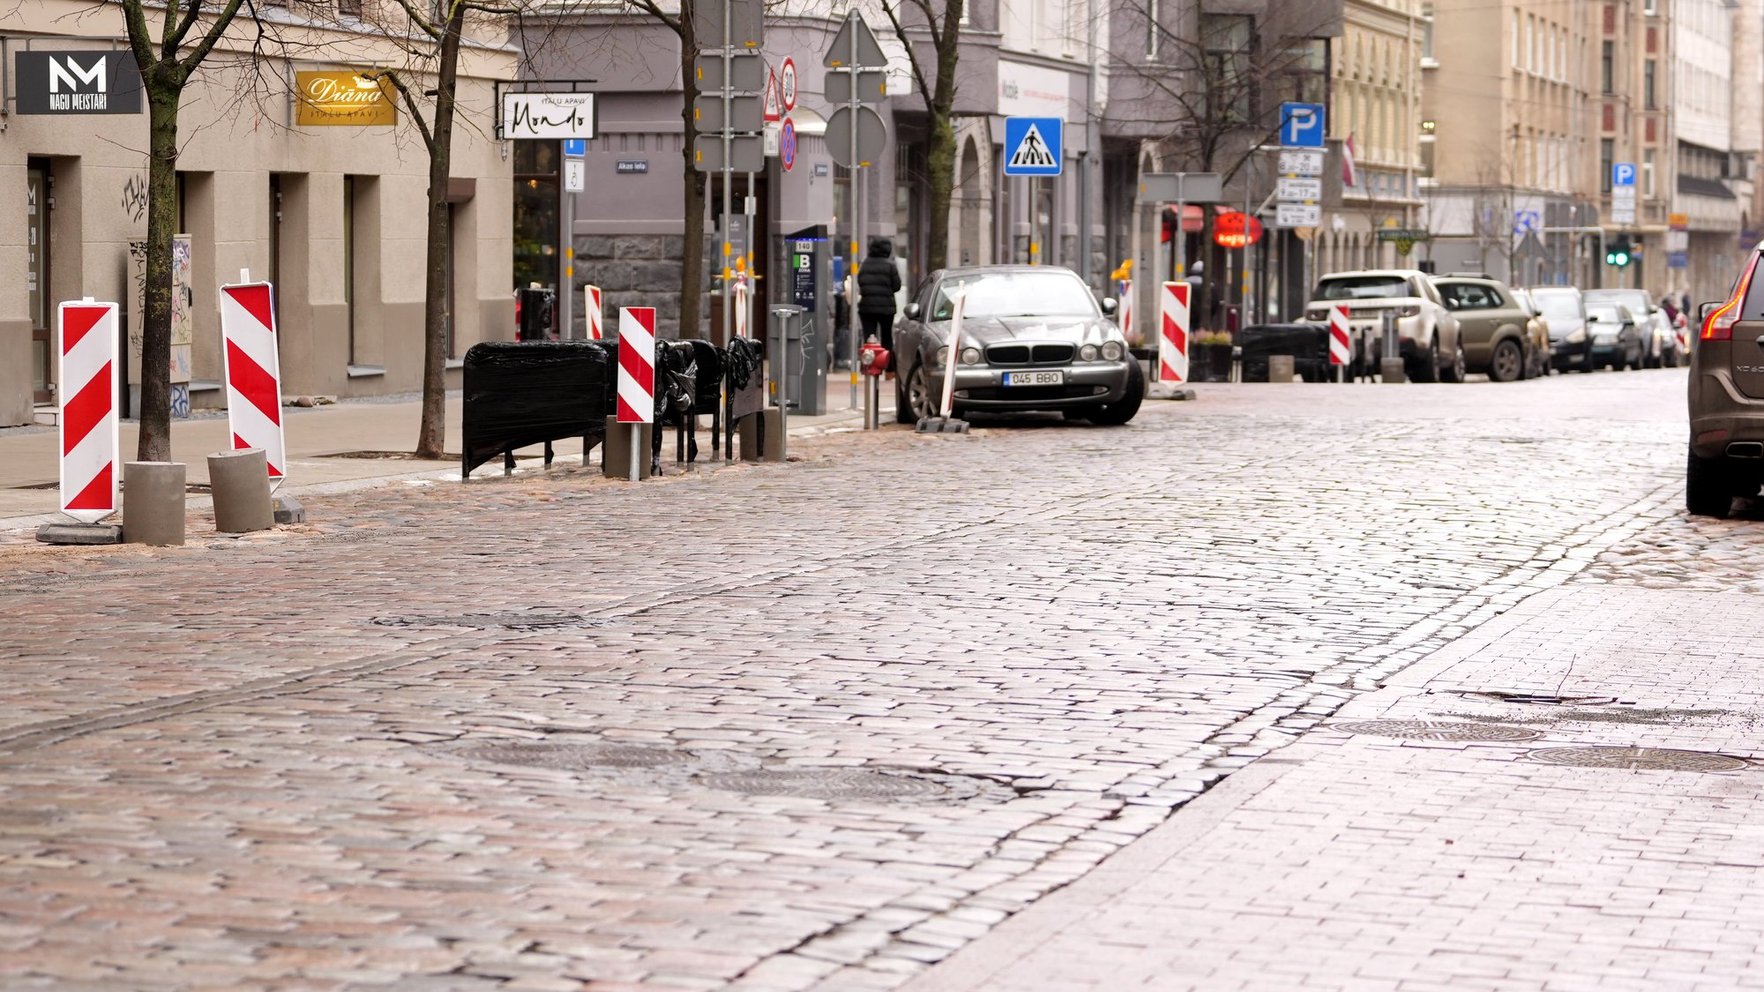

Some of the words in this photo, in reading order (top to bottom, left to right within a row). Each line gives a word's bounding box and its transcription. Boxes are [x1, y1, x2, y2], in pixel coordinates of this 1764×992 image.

[307, 78, 382, 104] Diāna
[49, 94, 70, 110] NAGU
[72, 93, 107, 110] MEISTARI
[512, 102, 584, 134] Mondo
[1290, 109, 1317, 142] P
[1618, 166, 1632, 183] P
[798, 242, 810, 250] 140
[799, 254, 811, 269] B
[1012, 374, 1031, 384] 045
